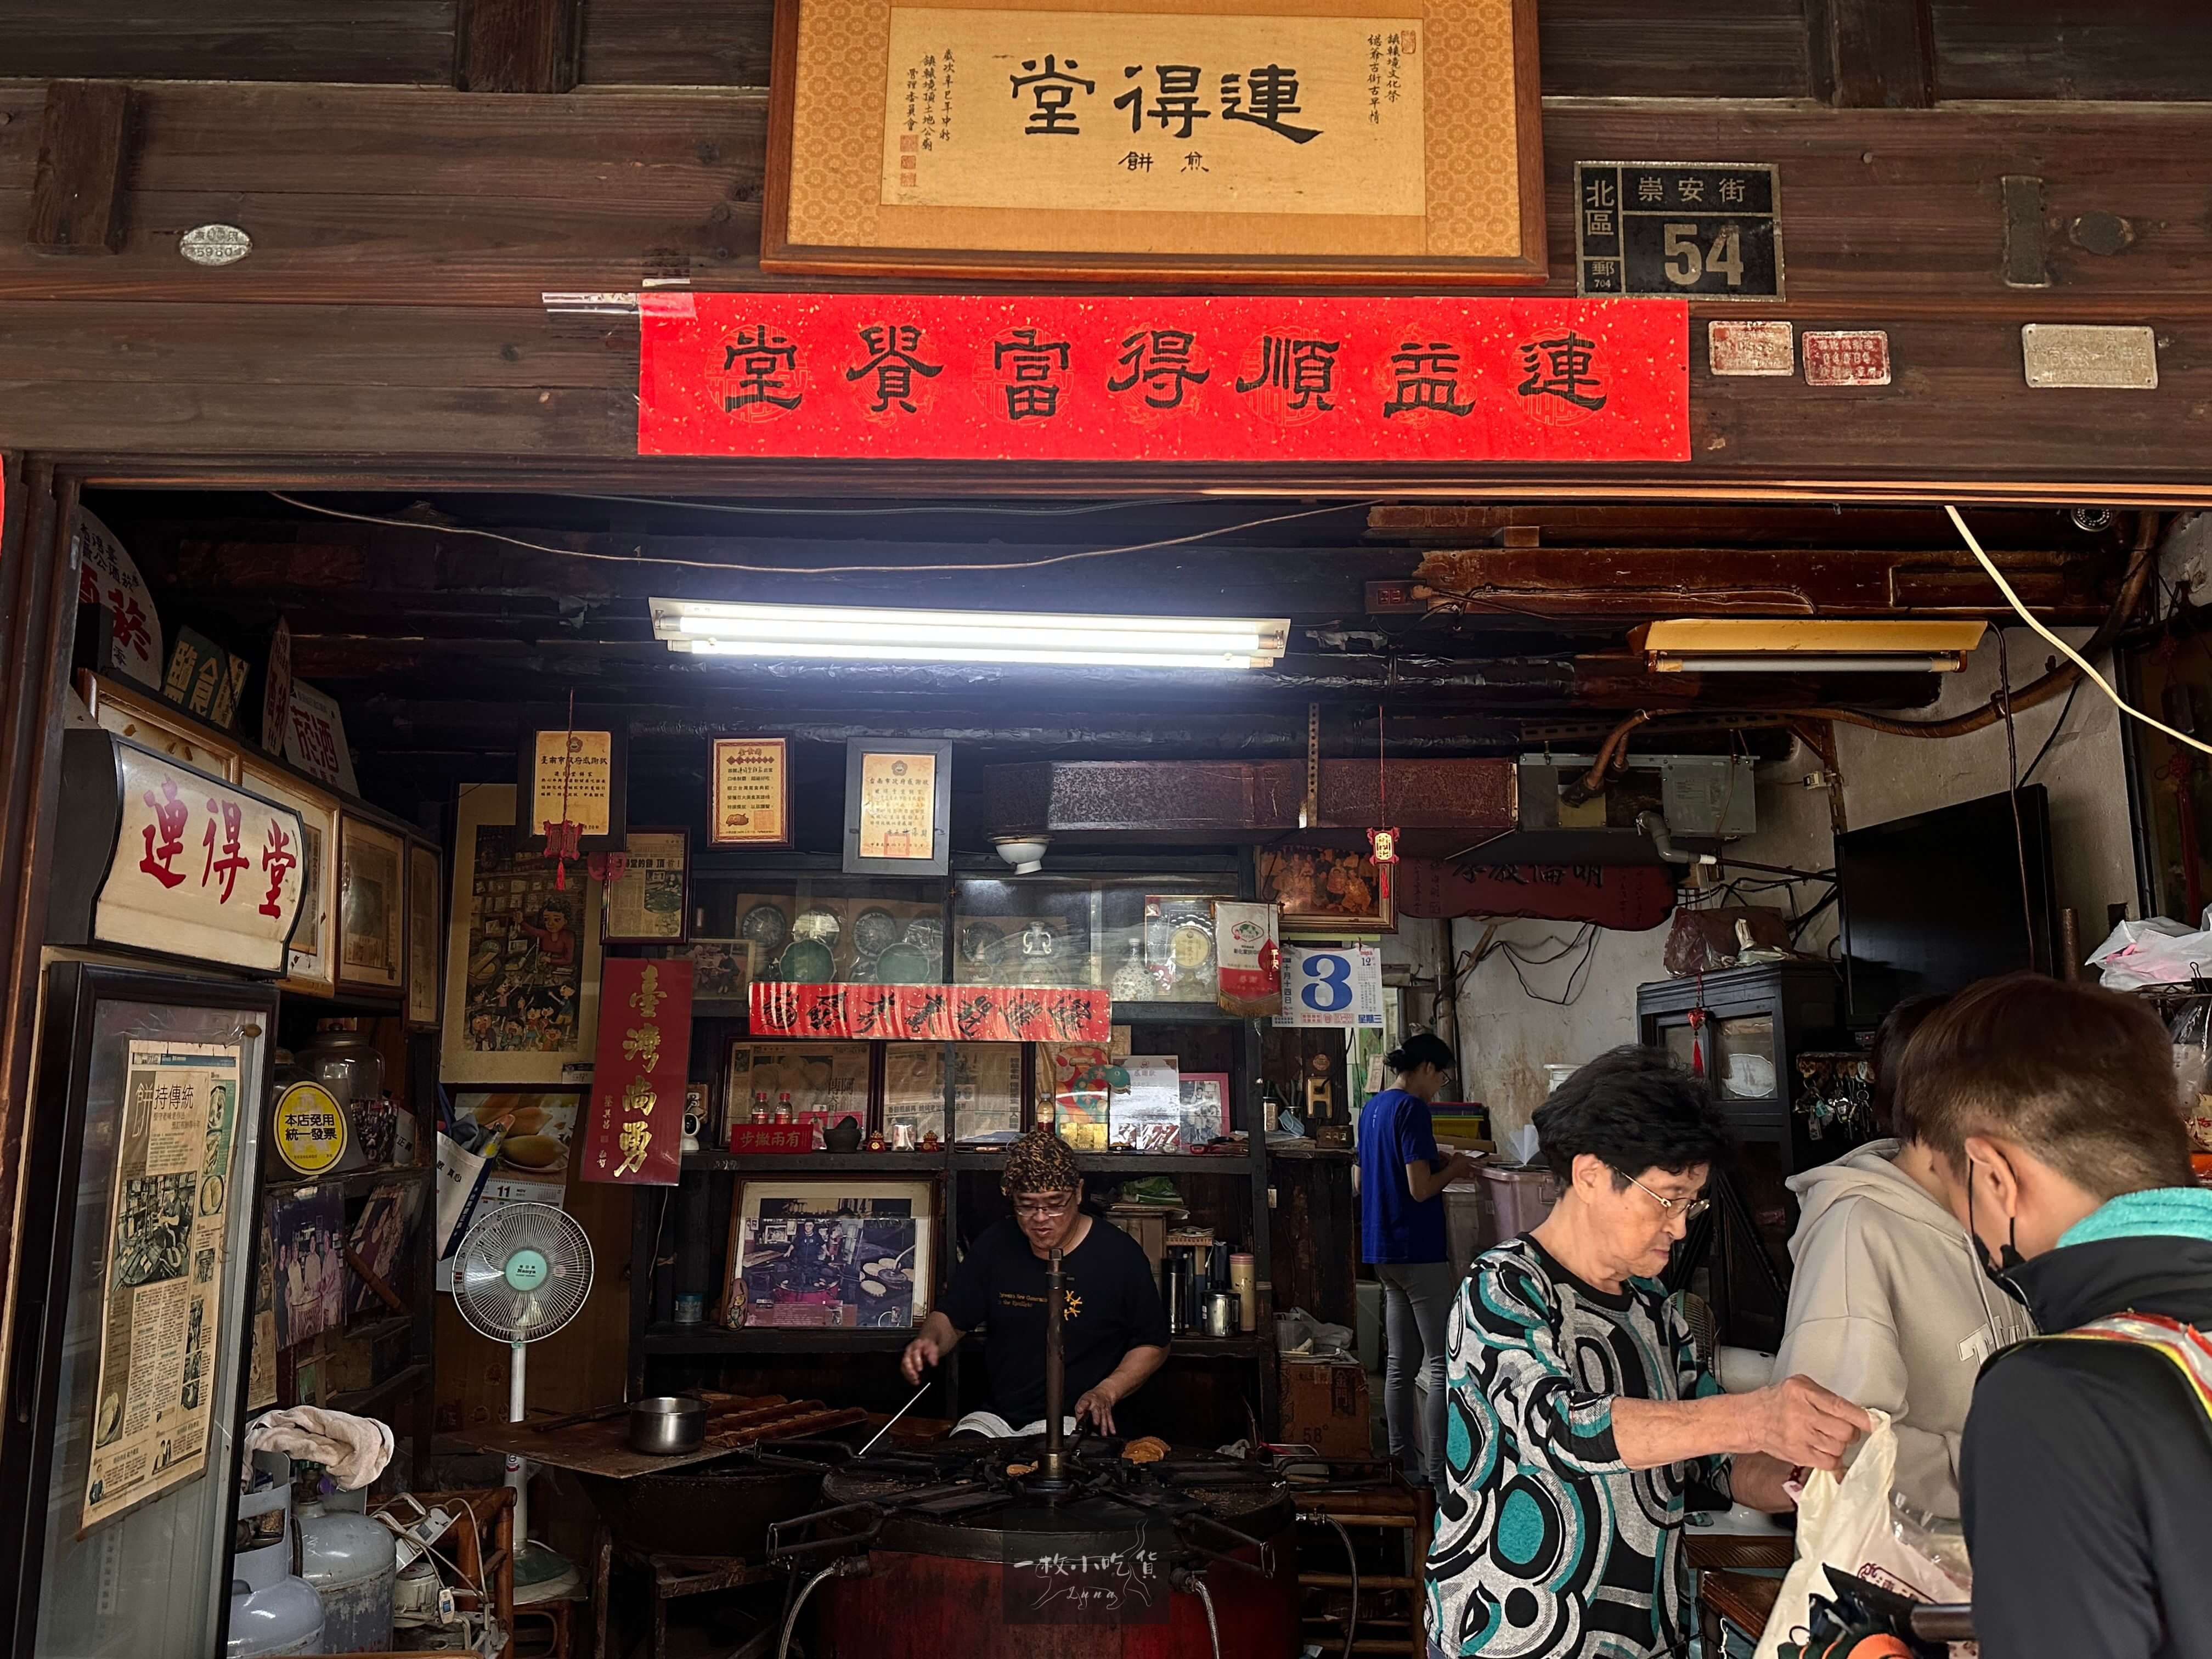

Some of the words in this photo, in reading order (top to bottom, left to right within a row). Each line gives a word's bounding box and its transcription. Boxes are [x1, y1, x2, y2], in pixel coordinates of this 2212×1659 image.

[1009, 53, 1324, 145] 連得堂
[1638, 177, 1746, 203] 崇安街
[1584, 179, 1615, 236] 北區
[1663, 223, 1744, 286] 54
[1592, 261, 1615, 276] 郵
[1594, 279, 1611, 288] 704
[139, 774, 297, 919] 連得堂
[1361, 957, 1371, 966] 12
[1301, 954, 1353, 1012] 3
[1358, 1014, 1382, 1024] 星期三
[613, 964, 667, 1178] 臺灣尚勇
[285, 1114, 335, 1127] 本店免用
[285, 1127, 337, 1142] 統一發票
[496, 1186, 511, 1198] 11
[1334, 1369, 1348, 1407] 金門
